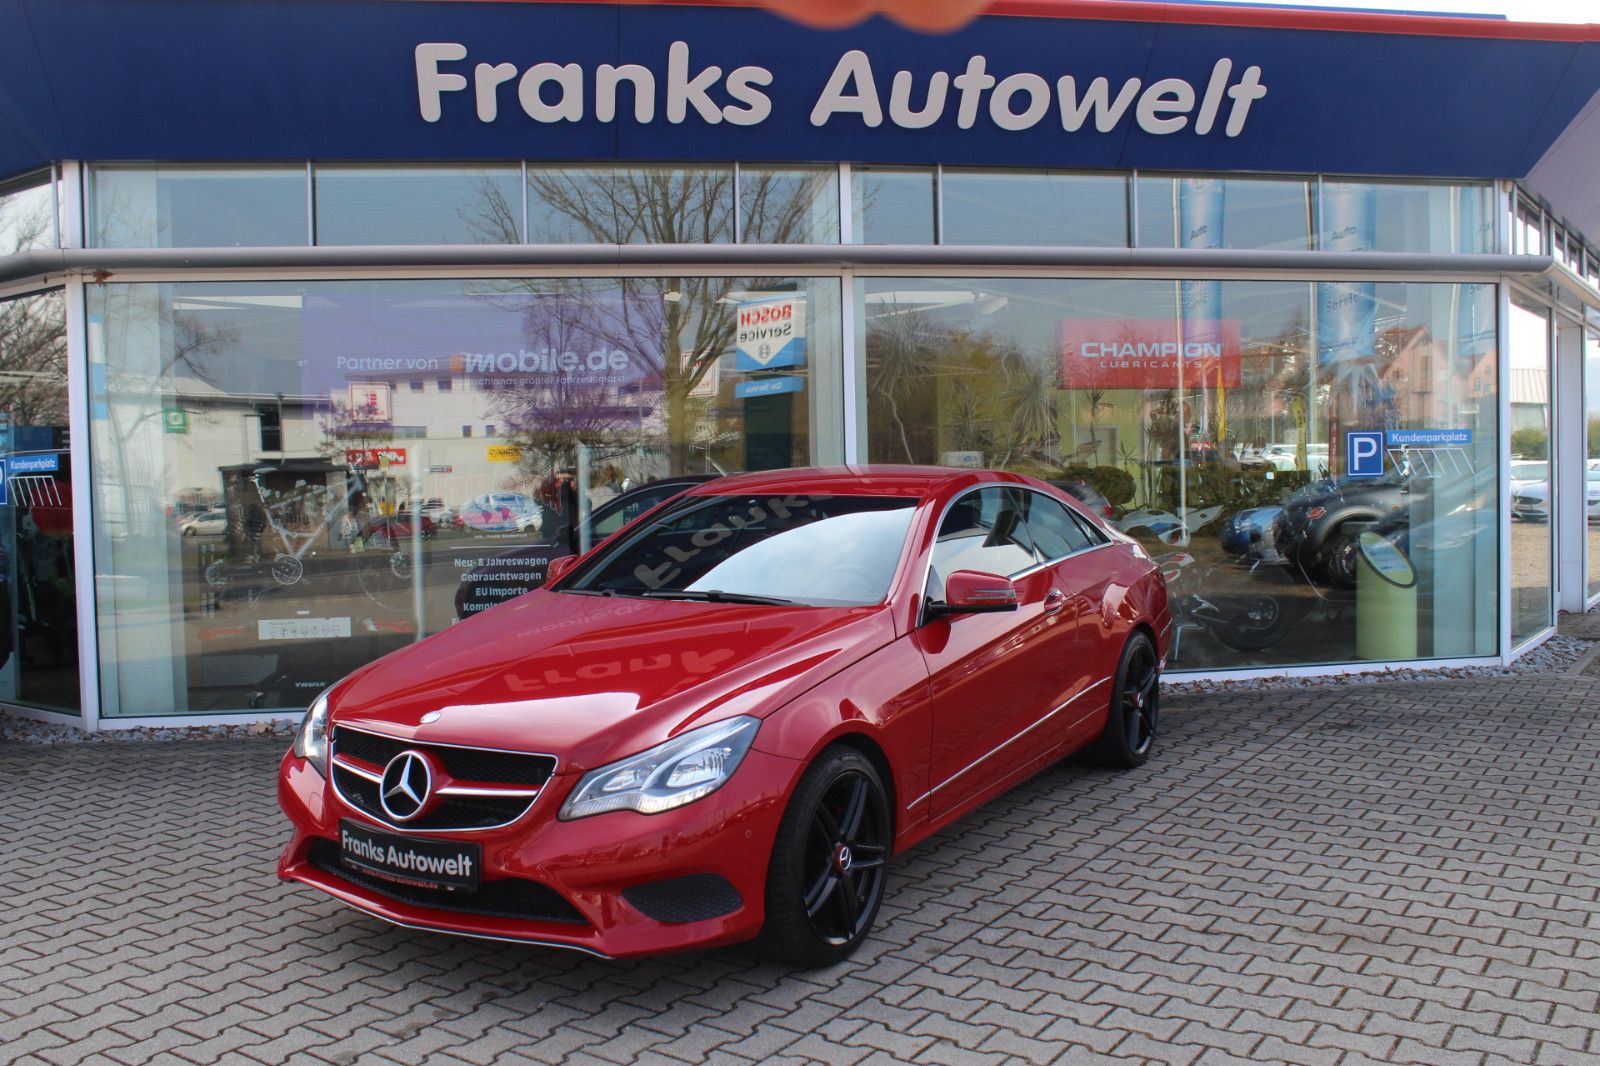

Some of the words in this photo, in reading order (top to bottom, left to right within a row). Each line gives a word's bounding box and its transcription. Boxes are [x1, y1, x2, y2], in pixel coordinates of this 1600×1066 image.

[414, 41, 774, 127] Franks
[809, 49, 1268, 138] Autowelt
[1080, 342, 1221, 358] CHAMPION
[337, 356, 402, 370] Partner
[406, 357, 439, 370] von
[464, 348, 629, 373] mobile.de
[1100, 360, 1203, 369] LUBRICANTS
[1353, 437, 1378, 471] P
[1392, 433, 1469, 444] Kundenparkplatz
[10, 459, 56, 471] Kundenparkplatz
[485, 557, 548, 569] Jahreswagen
[460, 571, 542, 583] Gebrauchtwagen
[475, 588, 488, 597] EU
[489, 586, 528, 600] Importe
[342, 829, 385, 863] Franks
[387, 845, 473, 877] Autowelt
